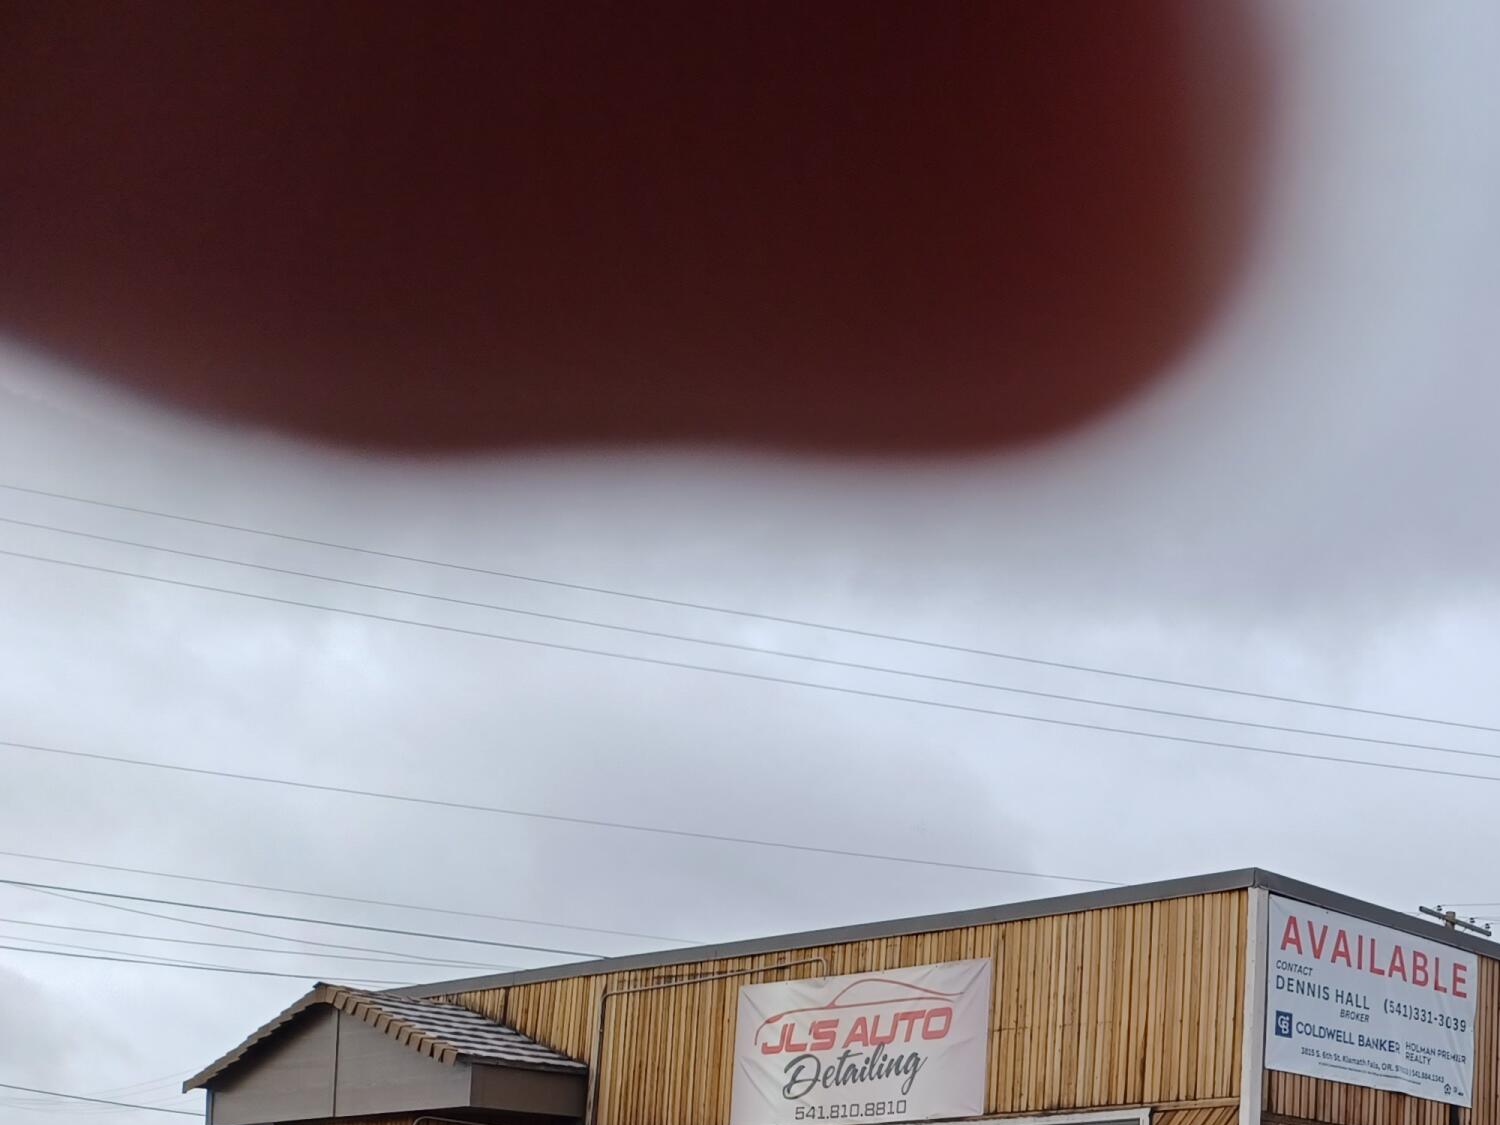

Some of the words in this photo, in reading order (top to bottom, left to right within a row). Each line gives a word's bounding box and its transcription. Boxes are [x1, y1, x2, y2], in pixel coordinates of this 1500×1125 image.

[1276, 959, 1313, 977] CONTACT
[1280, 916, 1468, 999] AVAILABLE
[1276, 974, 1330, 1001] DENNIS
[1335, 989, 1370, 1011] HALL
[842, 1006, 953, 1048] AUTO
[1339, 1008, 1370, 1023] BROKER
[1296, 1021, 1355, 1046] COLDWELL
[1358, 1034, 1400, 1054] BANKER
[1405, 1041, 1436, 1057] HOLMAN
[782, 1042, 929, 1101] Detailing
[1405, 1051, 1431, 1065] REALTY
[795, 1099, 907, 1121] 541.810.8810
